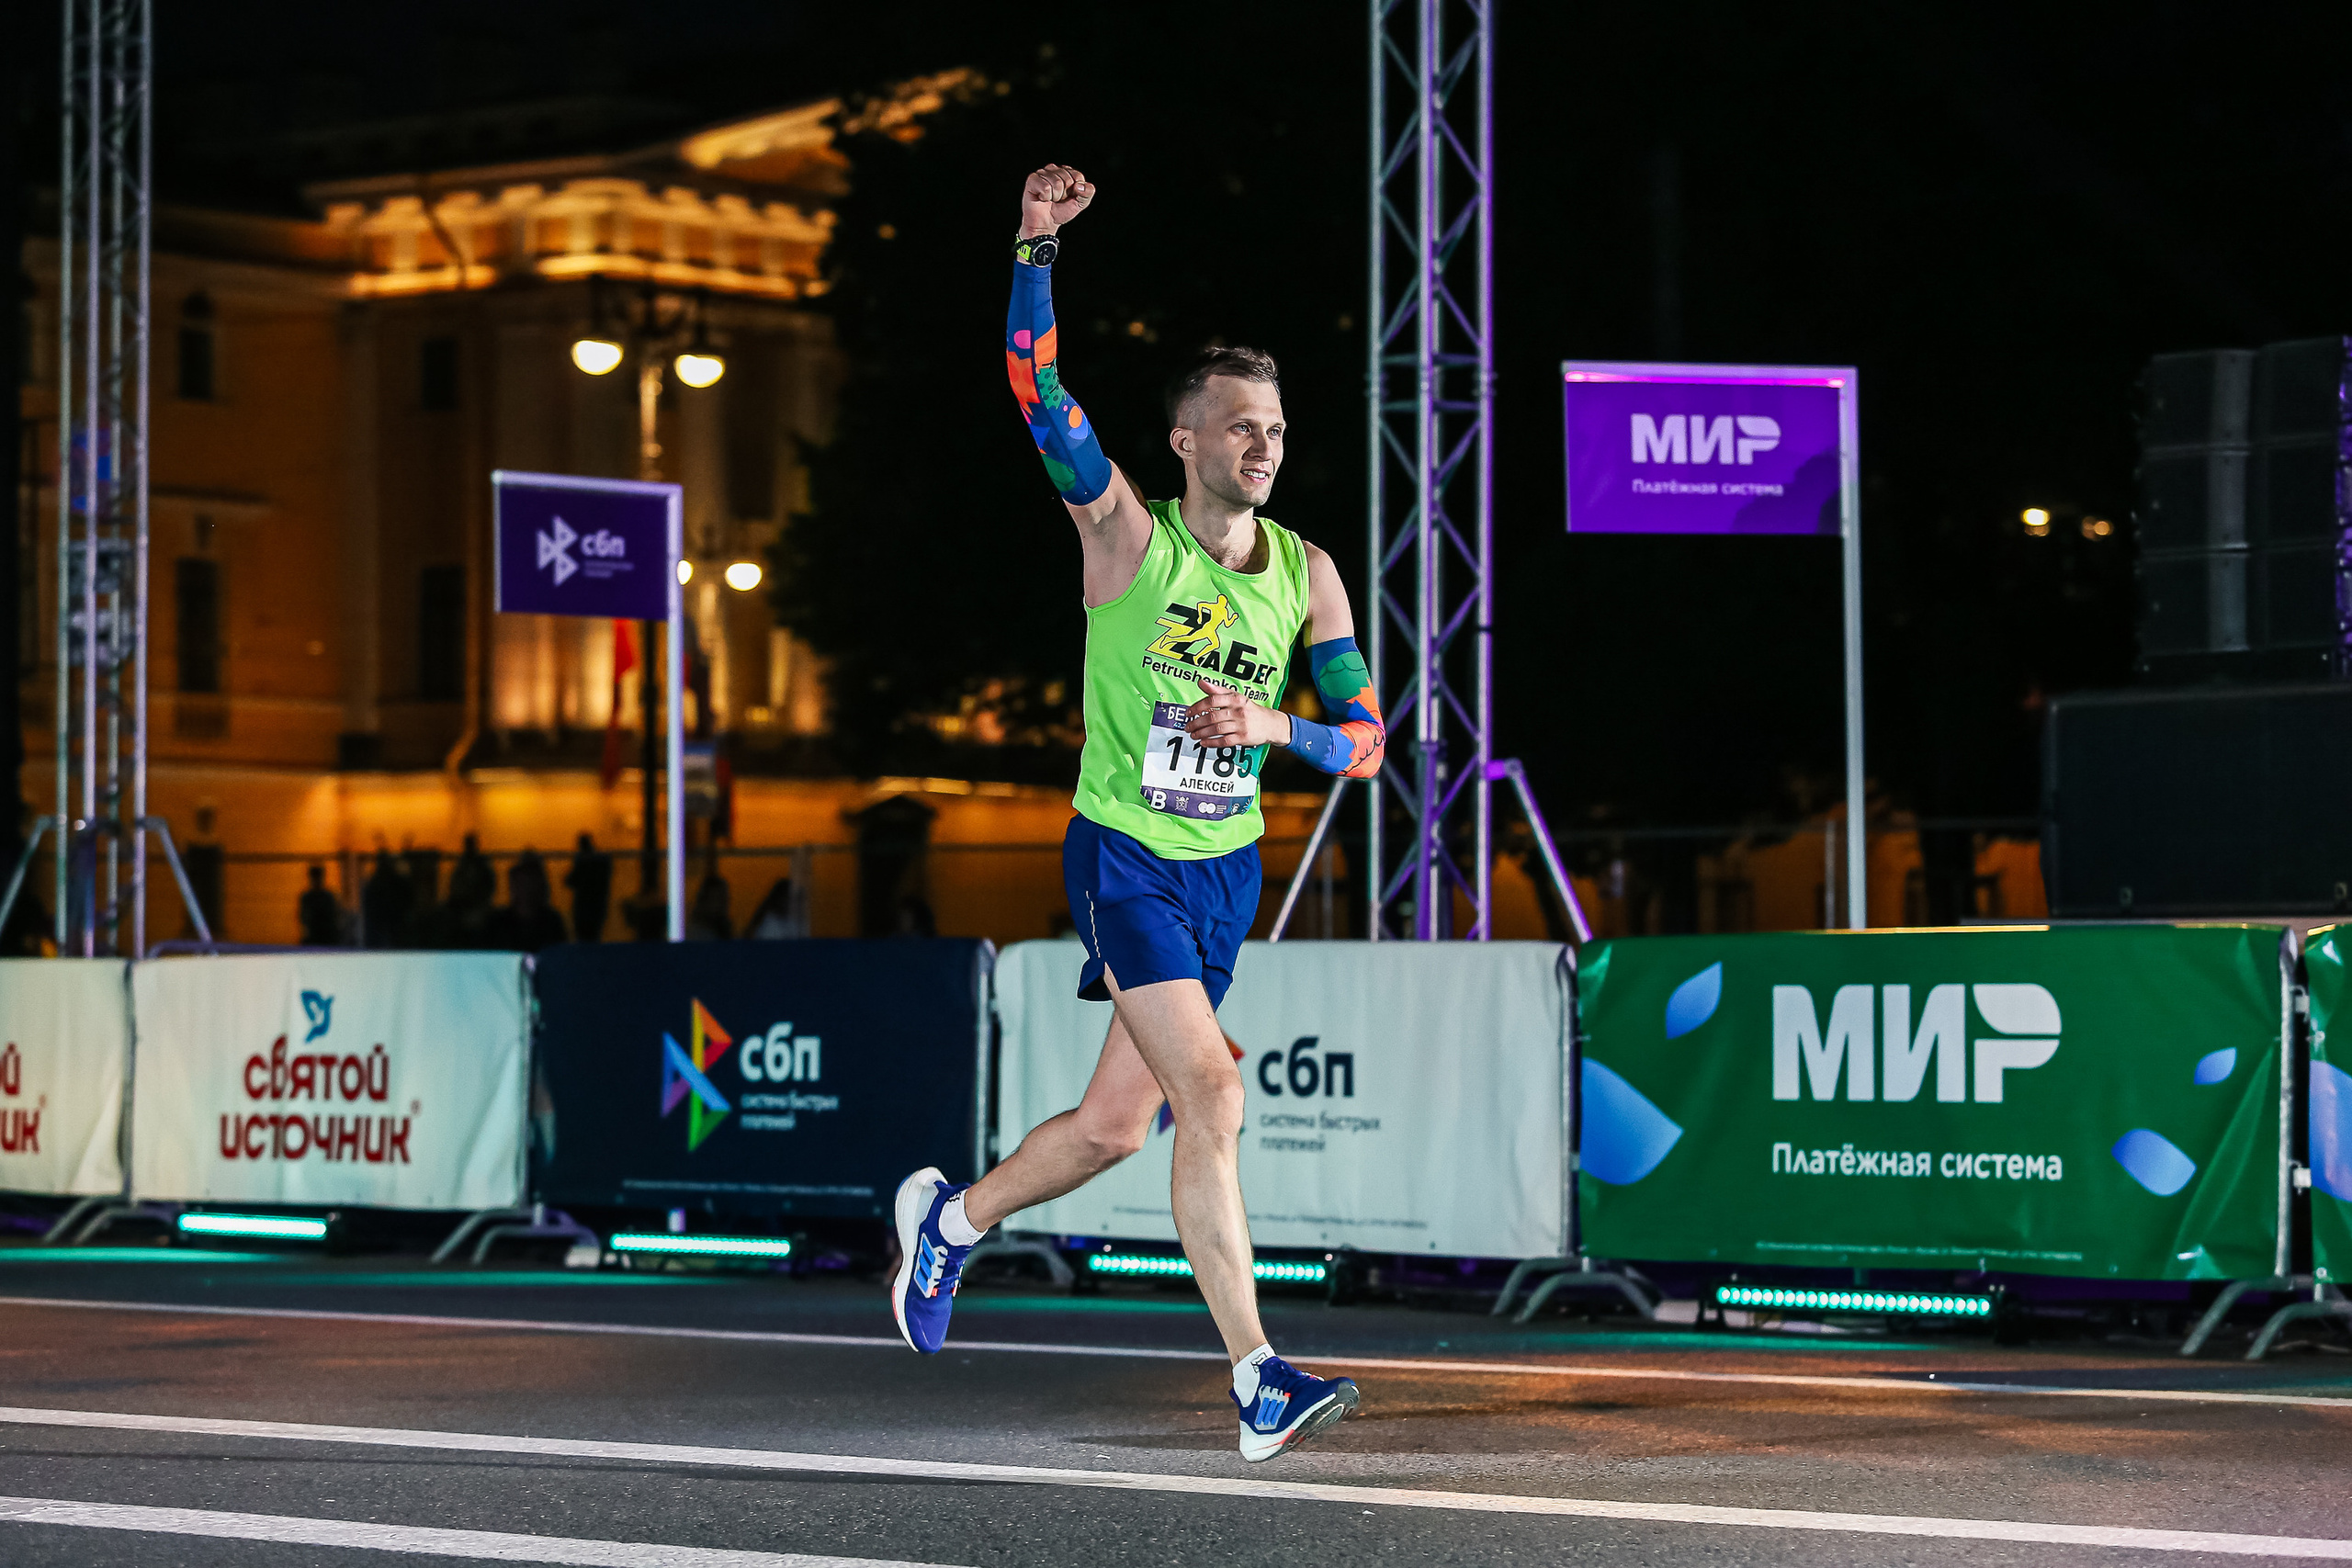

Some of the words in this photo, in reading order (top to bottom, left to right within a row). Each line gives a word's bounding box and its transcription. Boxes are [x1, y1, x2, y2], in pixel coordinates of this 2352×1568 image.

[1631, 413, 1781, 465] МИР
[1243, 685, 1270, 702] Team
[1166, 735, 1253, 779] 1185
[1179, 777, 1235, 794] АЛЕКСЕЙ
[243, 1033, 390, 1101] святой
[739, 1020, 821, 1083] сбп
[1258, 1035, 1355, 1098] сбп
[1772, 982, 2063, 1102] МИР
[1772, 1142, 1931, 1177] Платёжная
[1939, 1151, 2064, 1180] система
